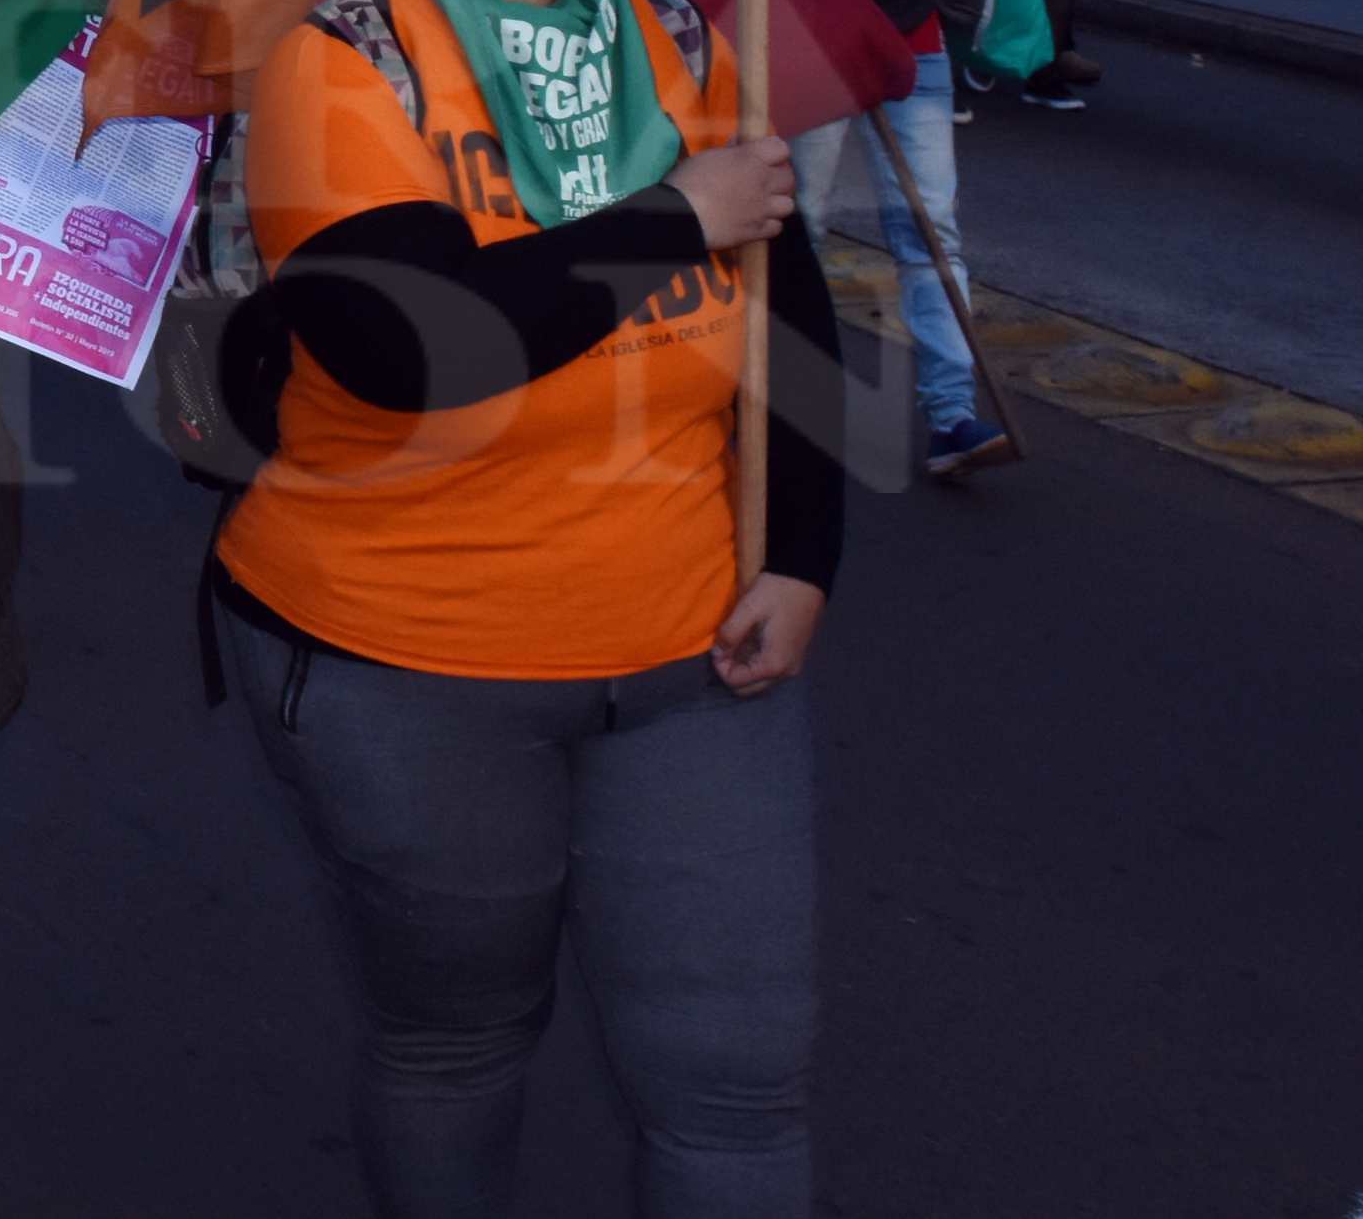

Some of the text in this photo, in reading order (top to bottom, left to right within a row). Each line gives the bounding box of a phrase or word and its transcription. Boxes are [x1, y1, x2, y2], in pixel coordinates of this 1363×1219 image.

[46, 283, 131, 327] SOCIALISTA
[53, 271, 134, 315] IZQUIERDA
[611, 331, 675, 358] IGLESIA
[679, 324, 704, 342] DEL
